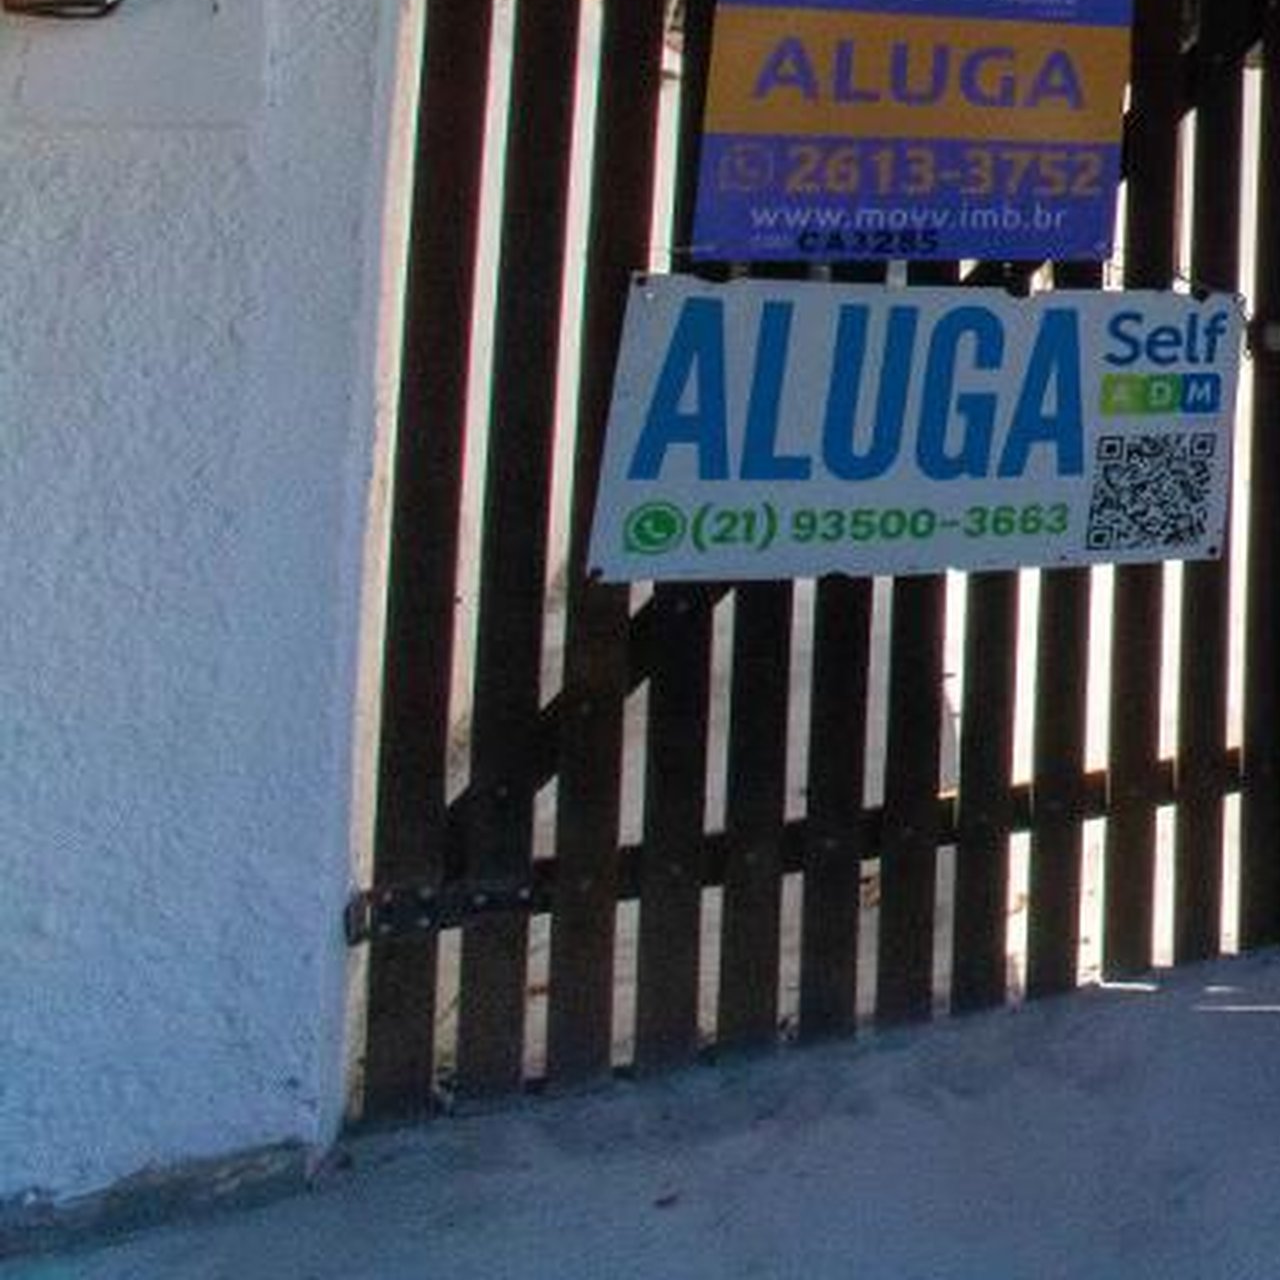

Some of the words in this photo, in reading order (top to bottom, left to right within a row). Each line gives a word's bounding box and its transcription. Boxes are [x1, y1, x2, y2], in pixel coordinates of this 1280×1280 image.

[754, 36, 1084, 110] ALUGA
[786, 145, 1101, 197] 2613-3752
[750, 204, 1067, 231] www.movv.imb.br
[1104, 311, 1228, 367] Self
[627, 297, 1085, 482] ALUGA
[690, 502, 778, 552] (21)
[792, 501, 1070, 544] 93500-3663
